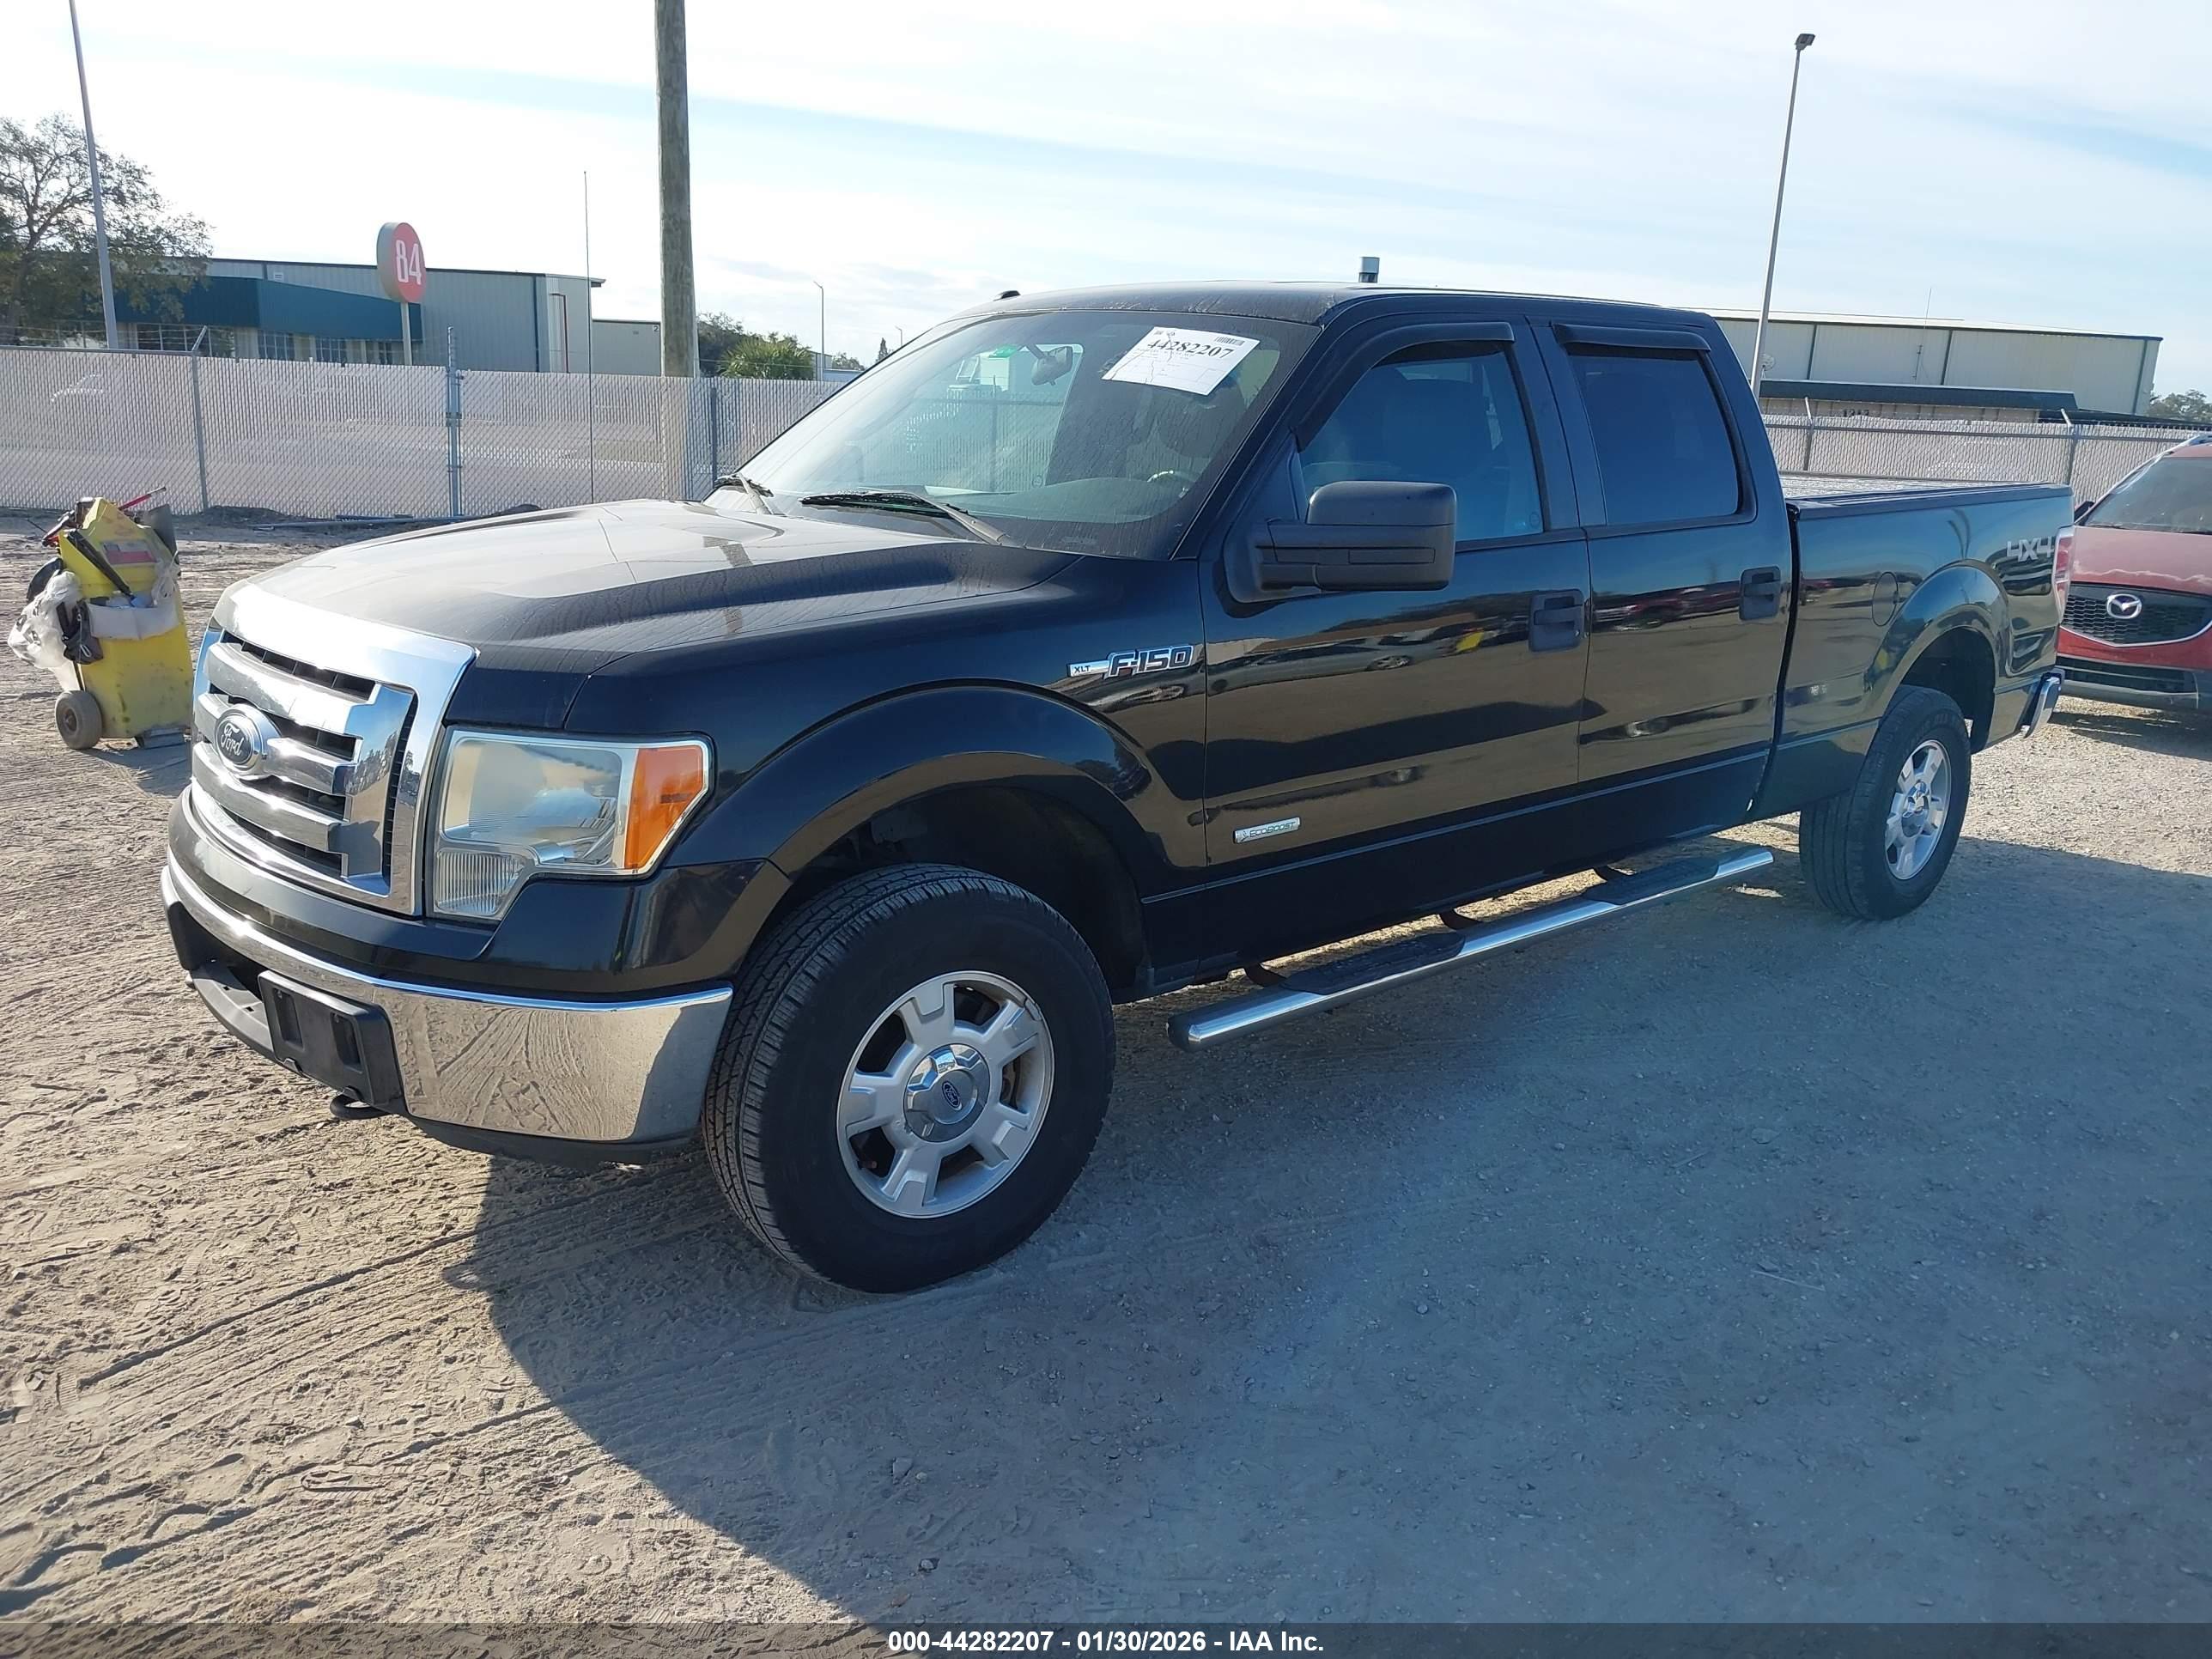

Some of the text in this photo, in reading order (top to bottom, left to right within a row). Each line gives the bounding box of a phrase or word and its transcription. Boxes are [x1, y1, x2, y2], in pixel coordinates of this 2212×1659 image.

[396, 240, 422, 285] 84
[1147, 339, 1235, 359] 44282207
[1074, 665, 1091, 674] XLT
[221, 722, 245, 756] Ford
